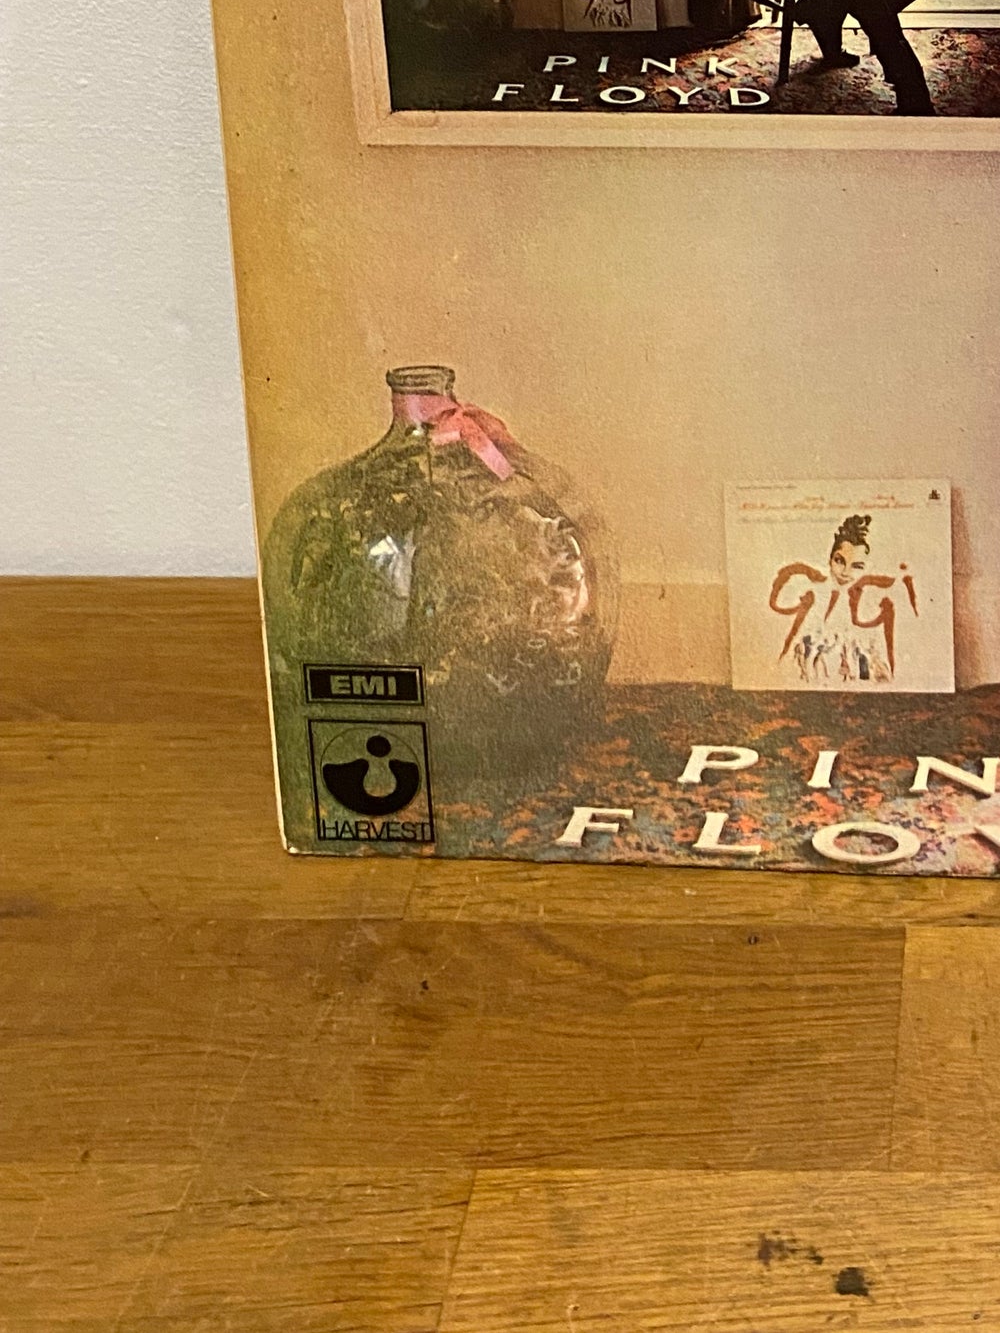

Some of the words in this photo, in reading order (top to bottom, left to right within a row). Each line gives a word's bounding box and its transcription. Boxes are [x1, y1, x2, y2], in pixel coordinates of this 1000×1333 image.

[543, 55, 738, 77] PINK
[491, 83, 770, 106] FLOYD
[329, 674, 397, 696] EMI
[321, 819, 431, 841] HARVEST
